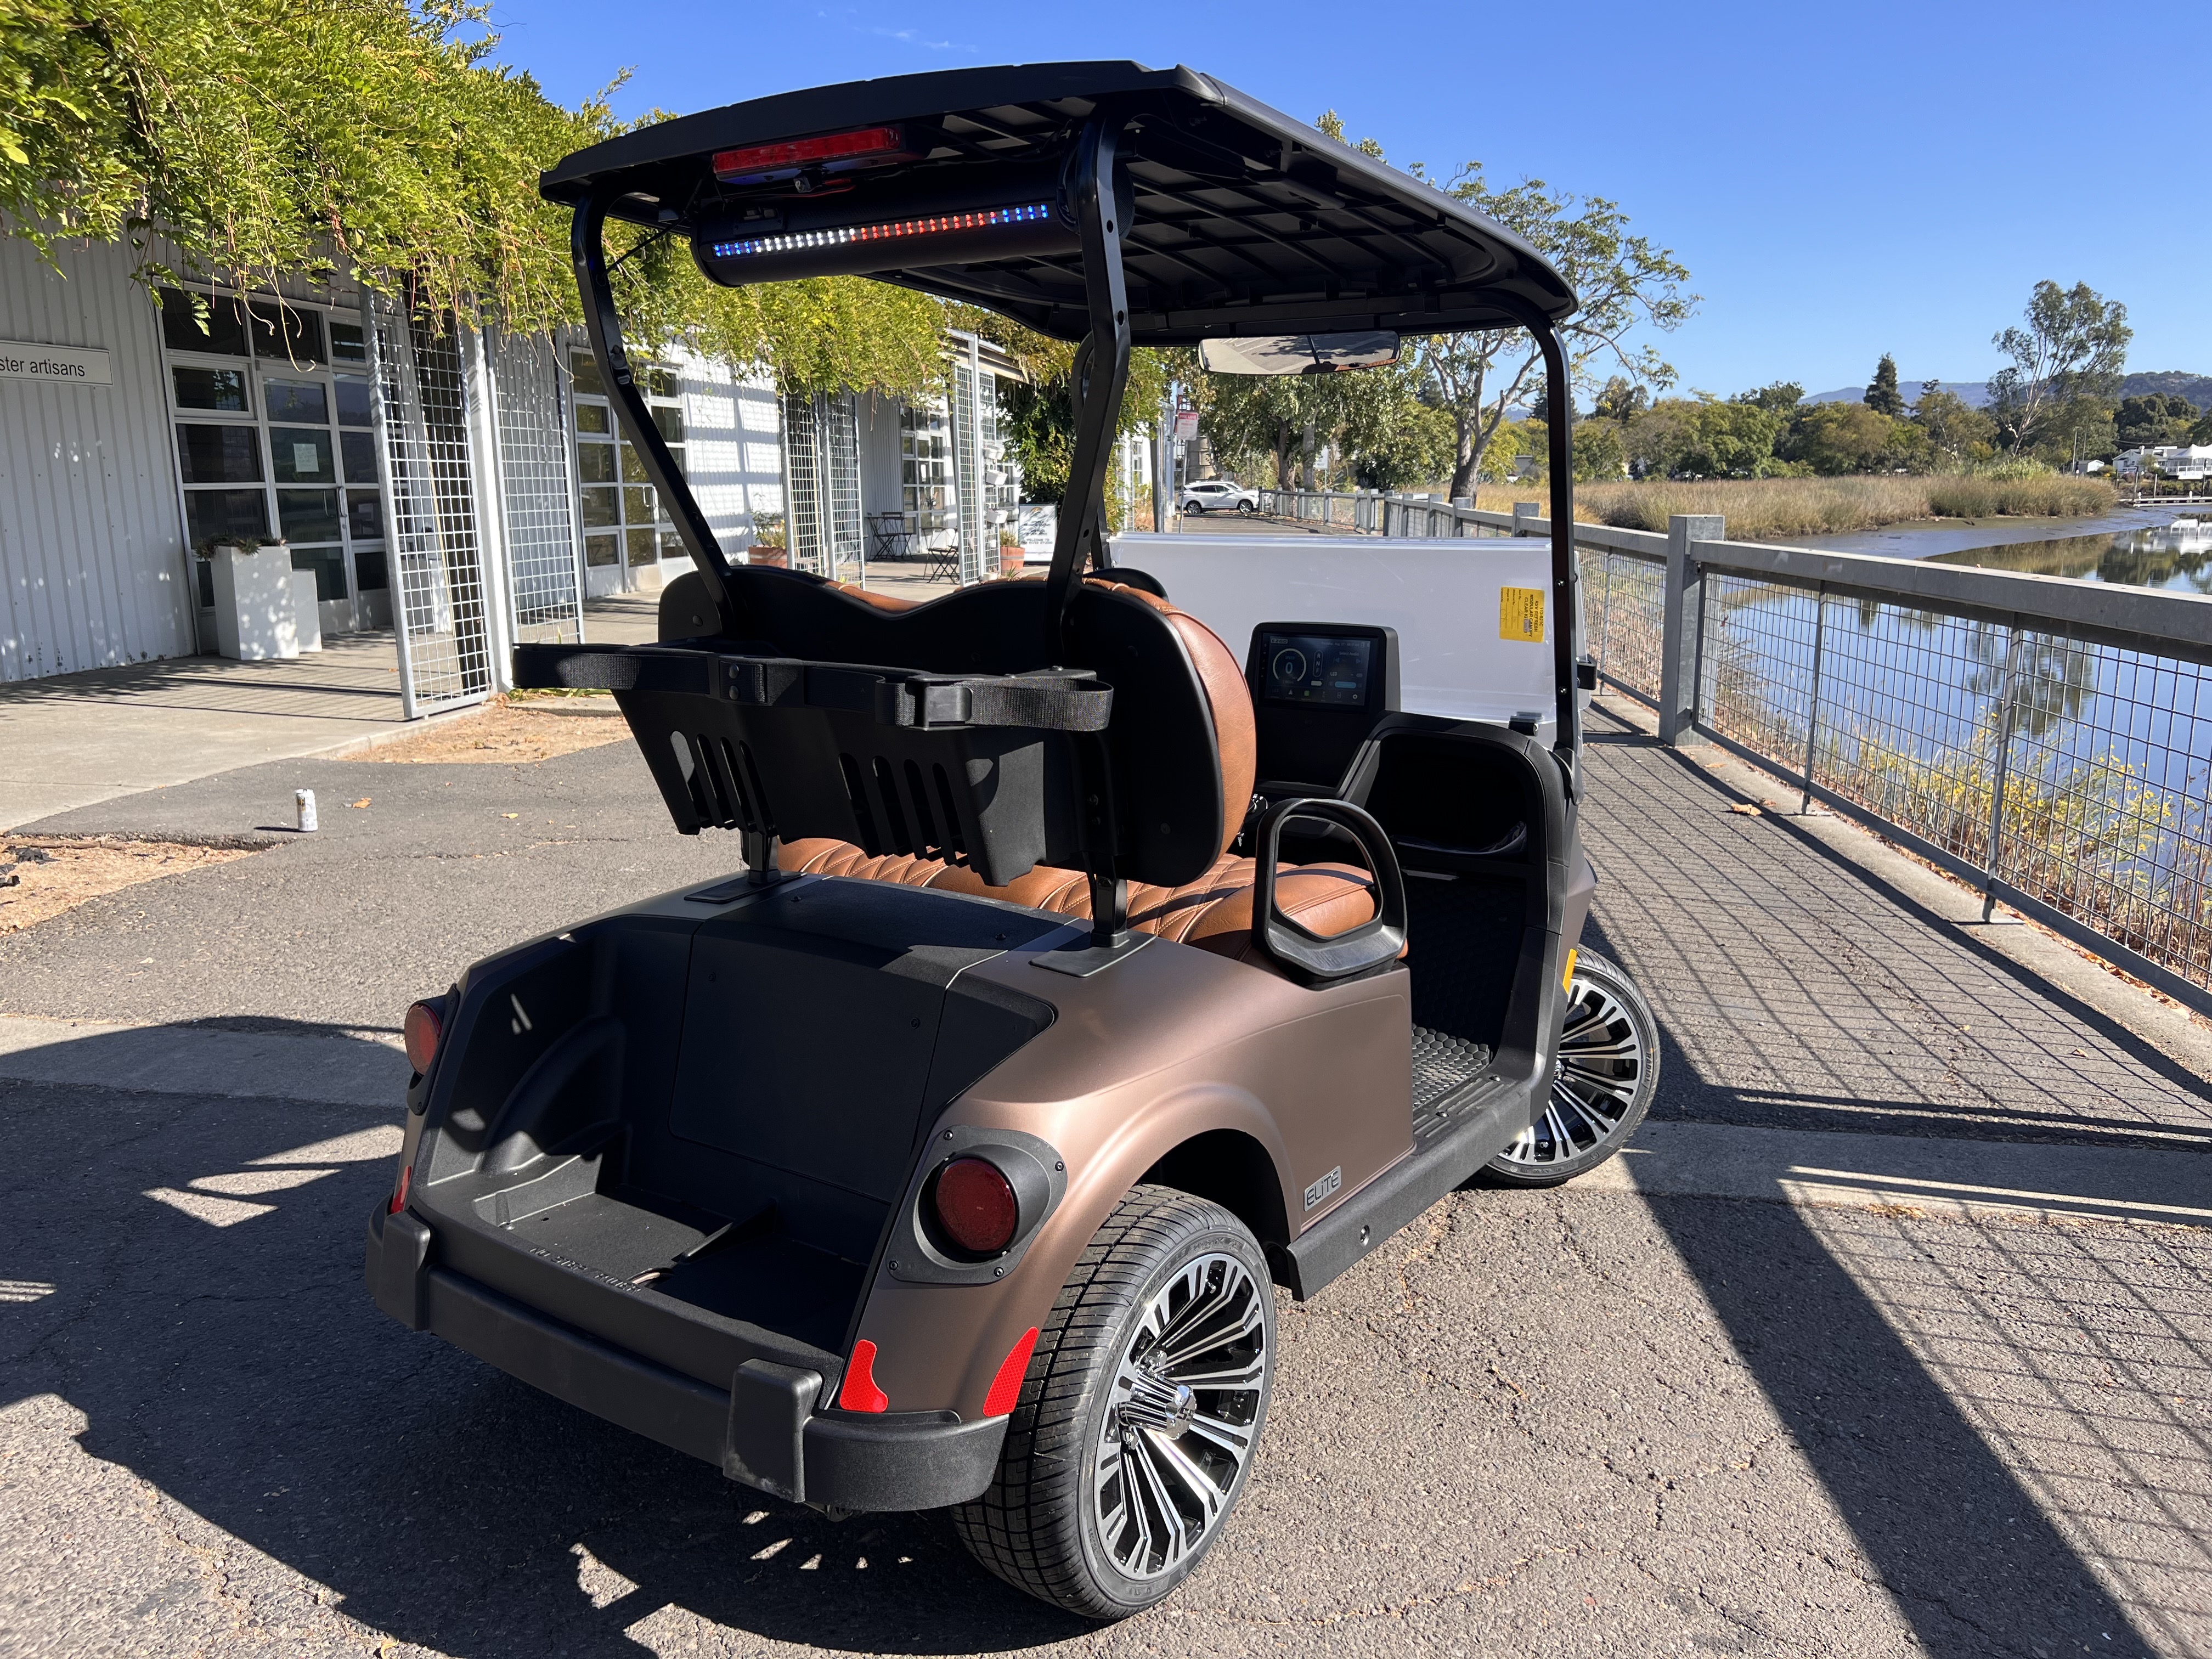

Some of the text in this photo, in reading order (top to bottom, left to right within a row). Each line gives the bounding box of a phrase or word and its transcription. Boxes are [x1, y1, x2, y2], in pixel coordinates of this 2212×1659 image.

[0, 356, 85, 377] ster artisans
[1285, 662, 1293, 674] 0
[1644, 1052, 1652, 1082] RADIAL
[529, 1248, 551, 1257] NO
[551, 1256, 589, 1272] STEP
